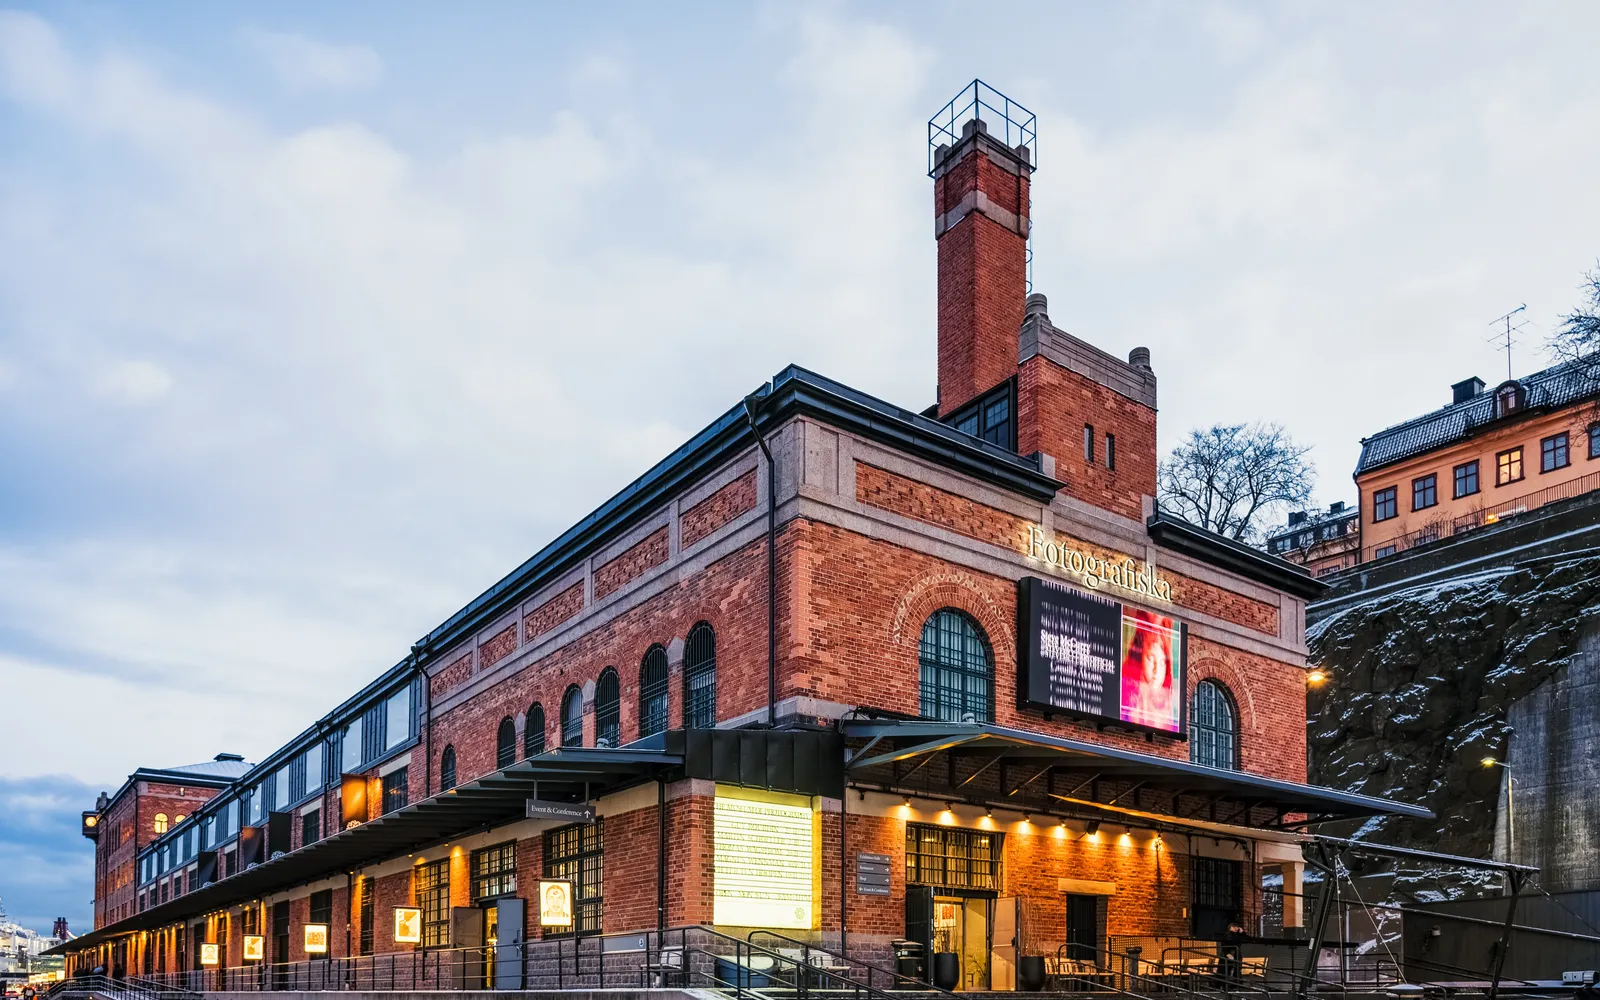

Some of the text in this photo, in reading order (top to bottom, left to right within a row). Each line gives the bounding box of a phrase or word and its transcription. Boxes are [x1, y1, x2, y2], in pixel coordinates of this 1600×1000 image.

[1027, 525, 1173, 602] Fotografiska
[531, 804, 582, 817] Event & Conference
